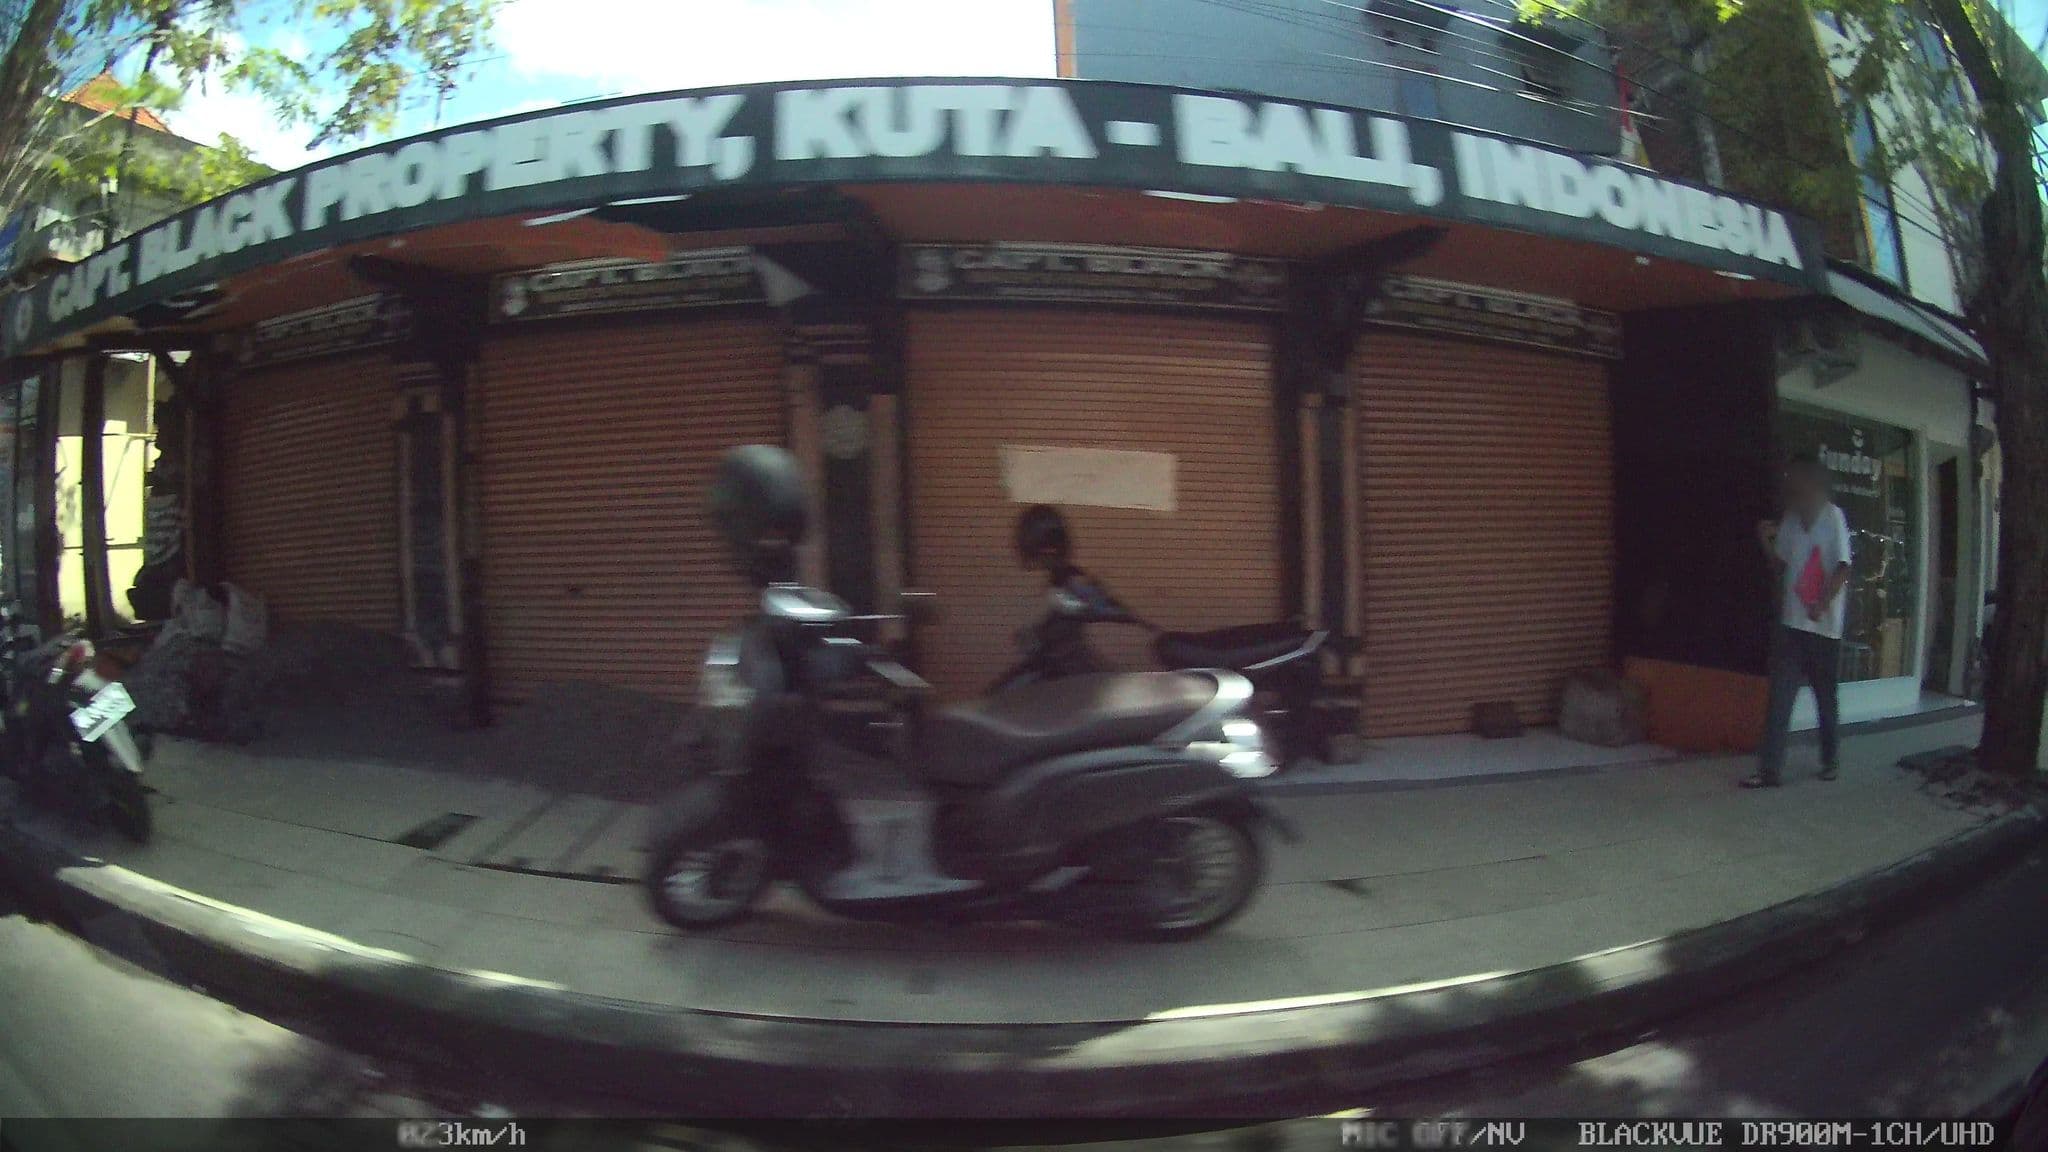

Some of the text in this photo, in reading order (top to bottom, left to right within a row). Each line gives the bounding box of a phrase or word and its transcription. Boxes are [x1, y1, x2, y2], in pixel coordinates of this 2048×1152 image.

[136, 177, 297, 285] BLACK
[302, 93, 756, 231] PROPERTY,
[773, 85, 1098, 161] KUTA
[1105, 120, 1160, 146] -
[1173, 93, 1442, 207] BALI,
[1452, 131, 1802, 270] INDONESIA
